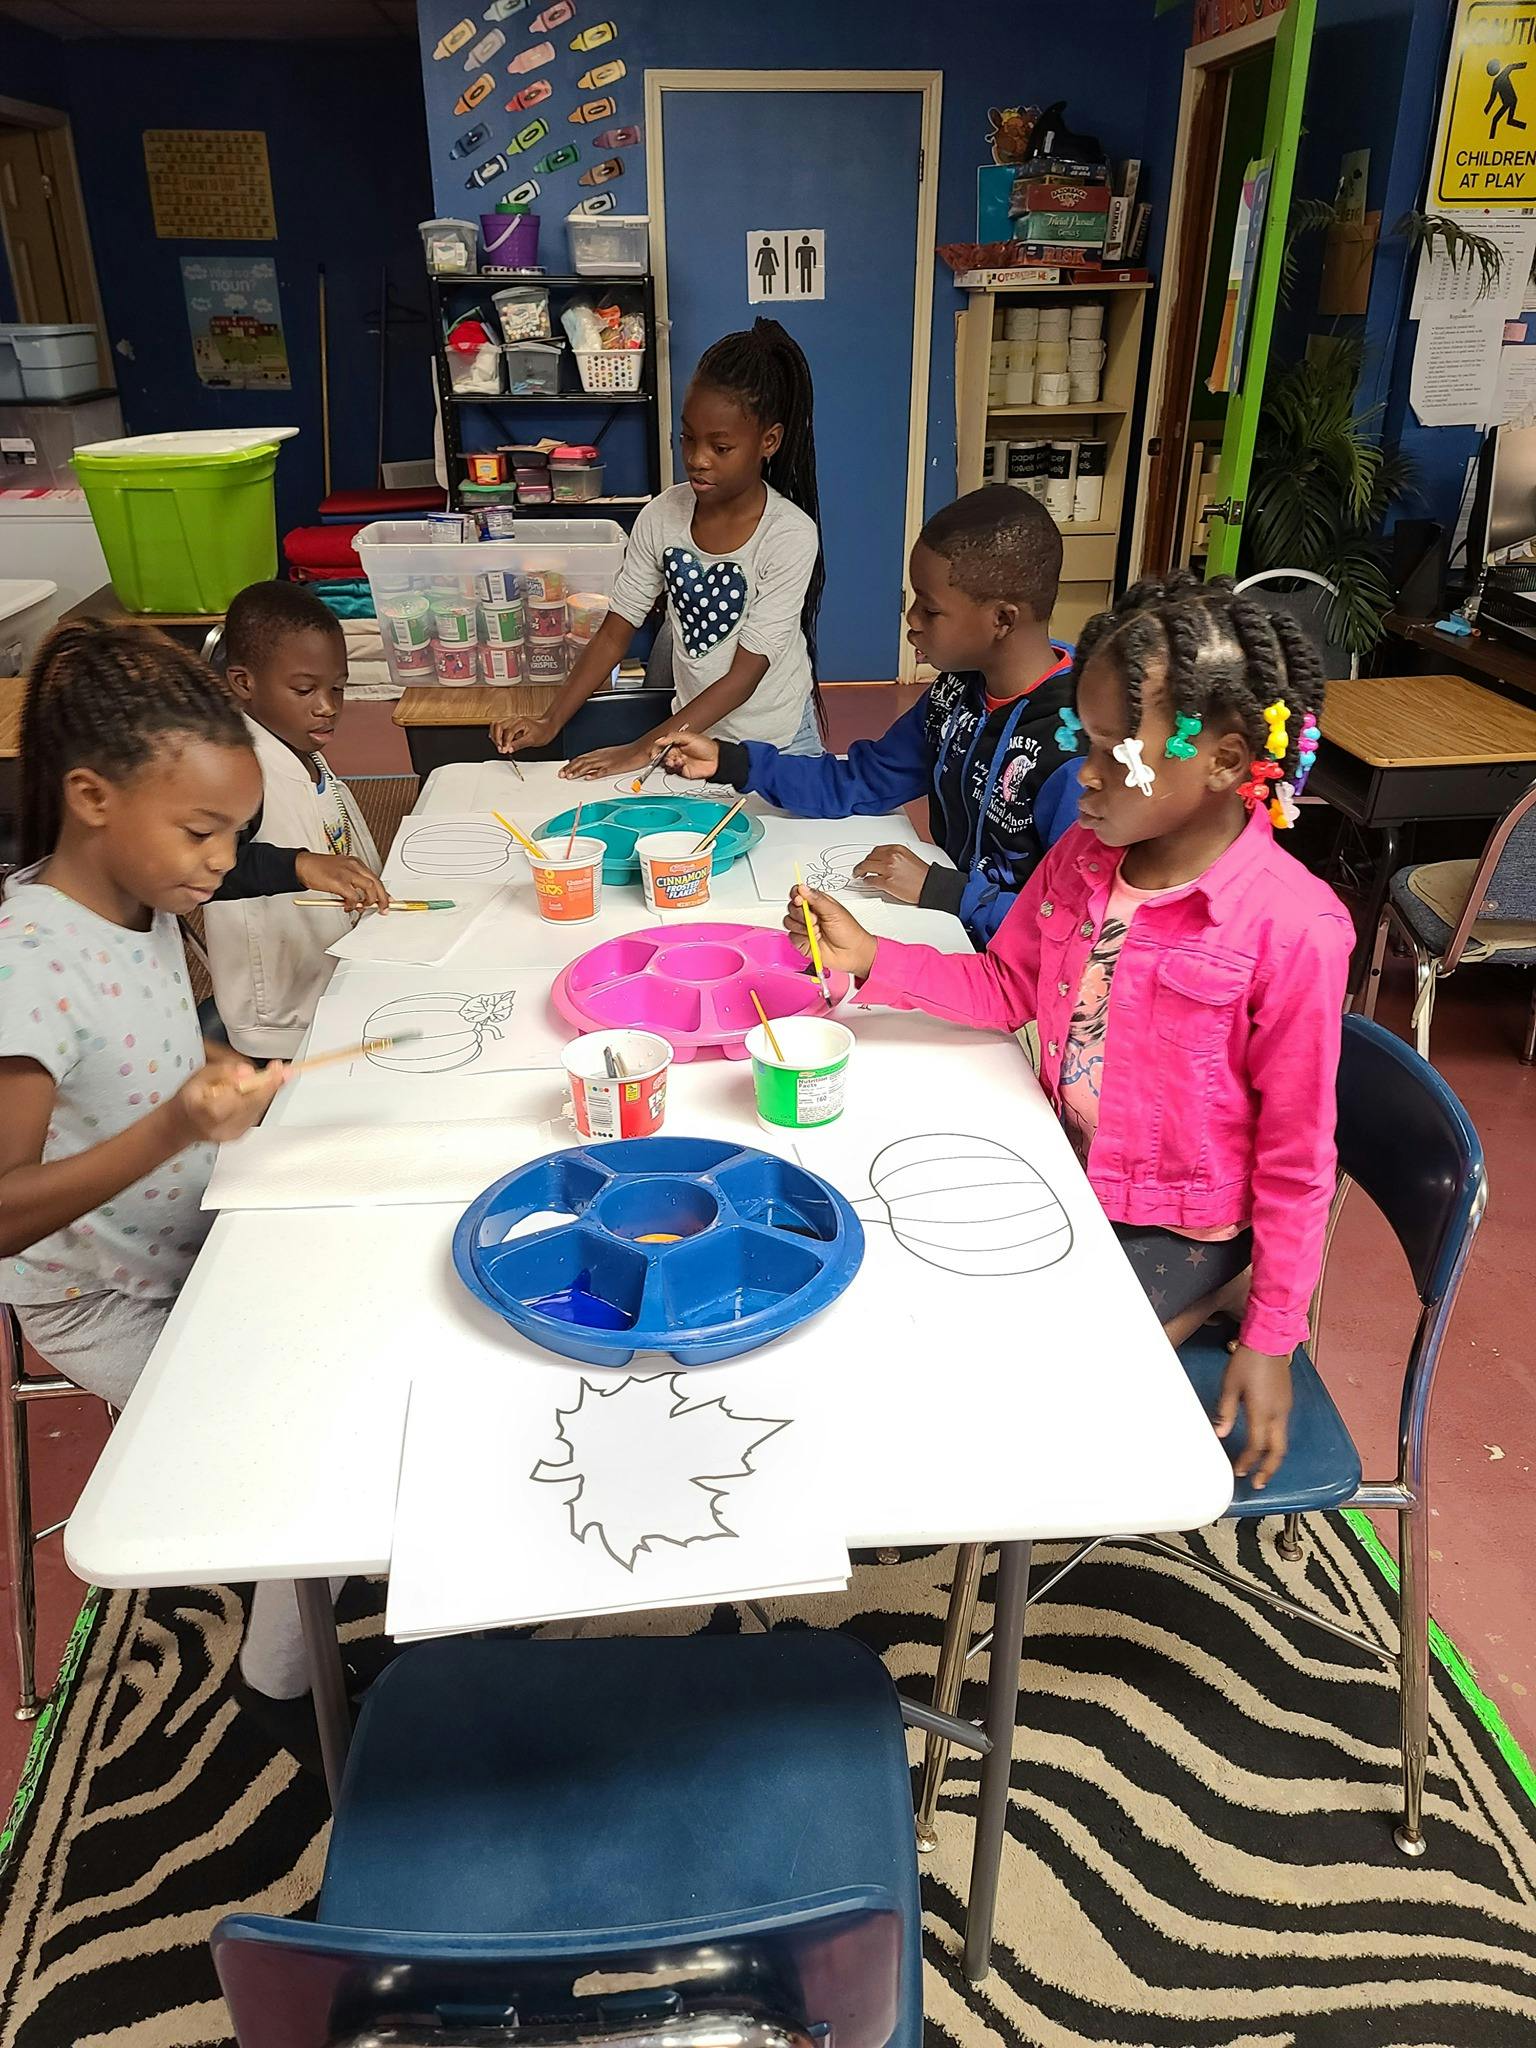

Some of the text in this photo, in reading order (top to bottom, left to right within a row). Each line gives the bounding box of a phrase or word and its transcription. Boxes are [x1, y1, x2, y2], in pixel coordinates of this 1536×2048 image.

[1473, 16, 1536, 46] CAUTI
[1455, 150, 1536, 167] CHILDREN
[1459, 172, 1526, 189] AT PLAY
[1046, 213, 1097, 229] Trivial Pursuit
[1041, 247, 1088, 265] RISK
[210, 279, 257, 293] noun?
[1011, 454, 1036, 463] paper
[1011, 464, 1035, 473] towels
[531, 654, 555, 662] COCOA
[530, 661, 559, 670] KRISPIES
[1009, 735, 1024, 750] AKE
[656, 867, 708, 888] CINNAMON
[666, 880, 700, 893] FROSTED
[668, 888, 698, 900] FLAKES
